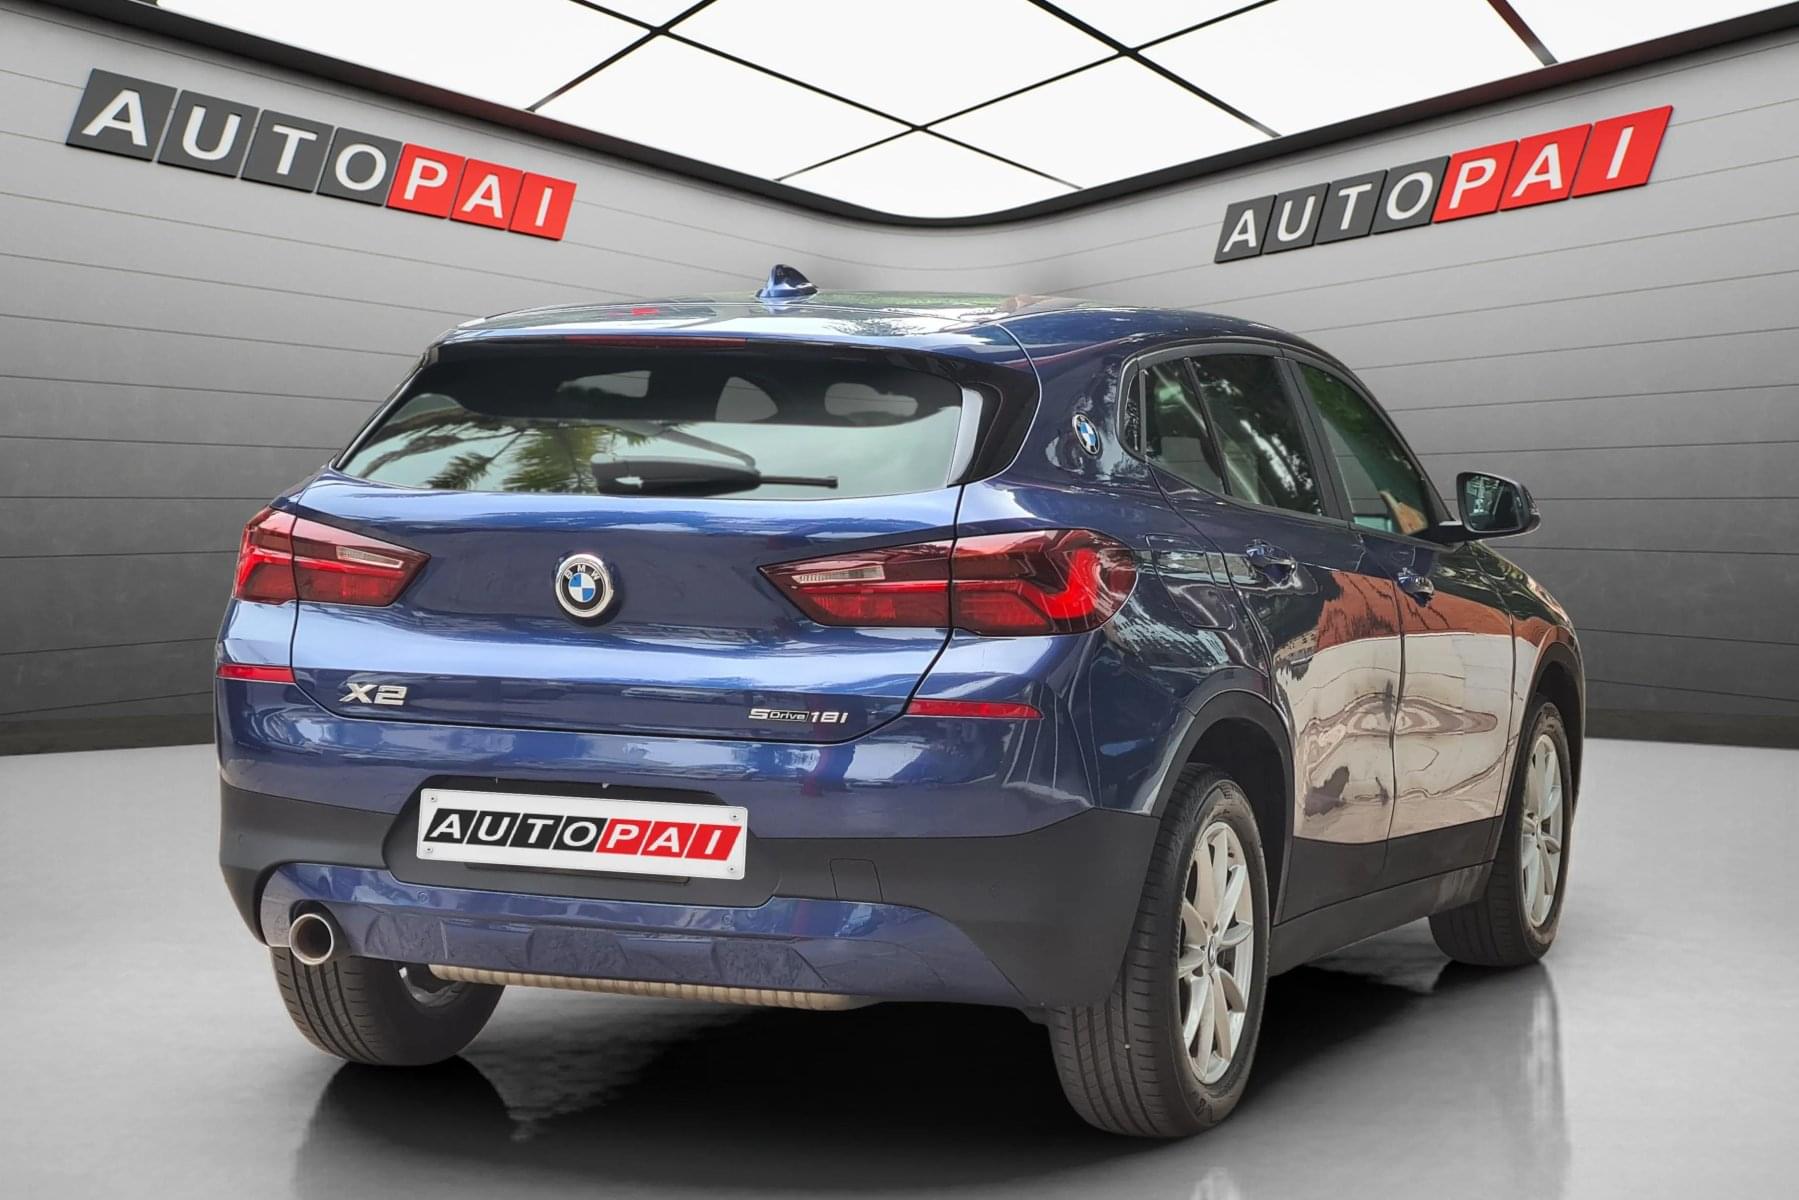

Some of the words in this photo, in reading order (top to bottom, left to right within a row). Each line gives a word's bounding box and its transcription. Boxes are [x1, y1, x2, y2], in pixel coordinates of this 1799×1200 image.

[82, 88, 552, 228] AUTOPAI
[1223, 126, 1634, 253] AUTOPAI
[564, 563, 601, 581] BMW
[339, 682, 408, 706] X2
[429, 813, 721, 855] AUTOPAI
